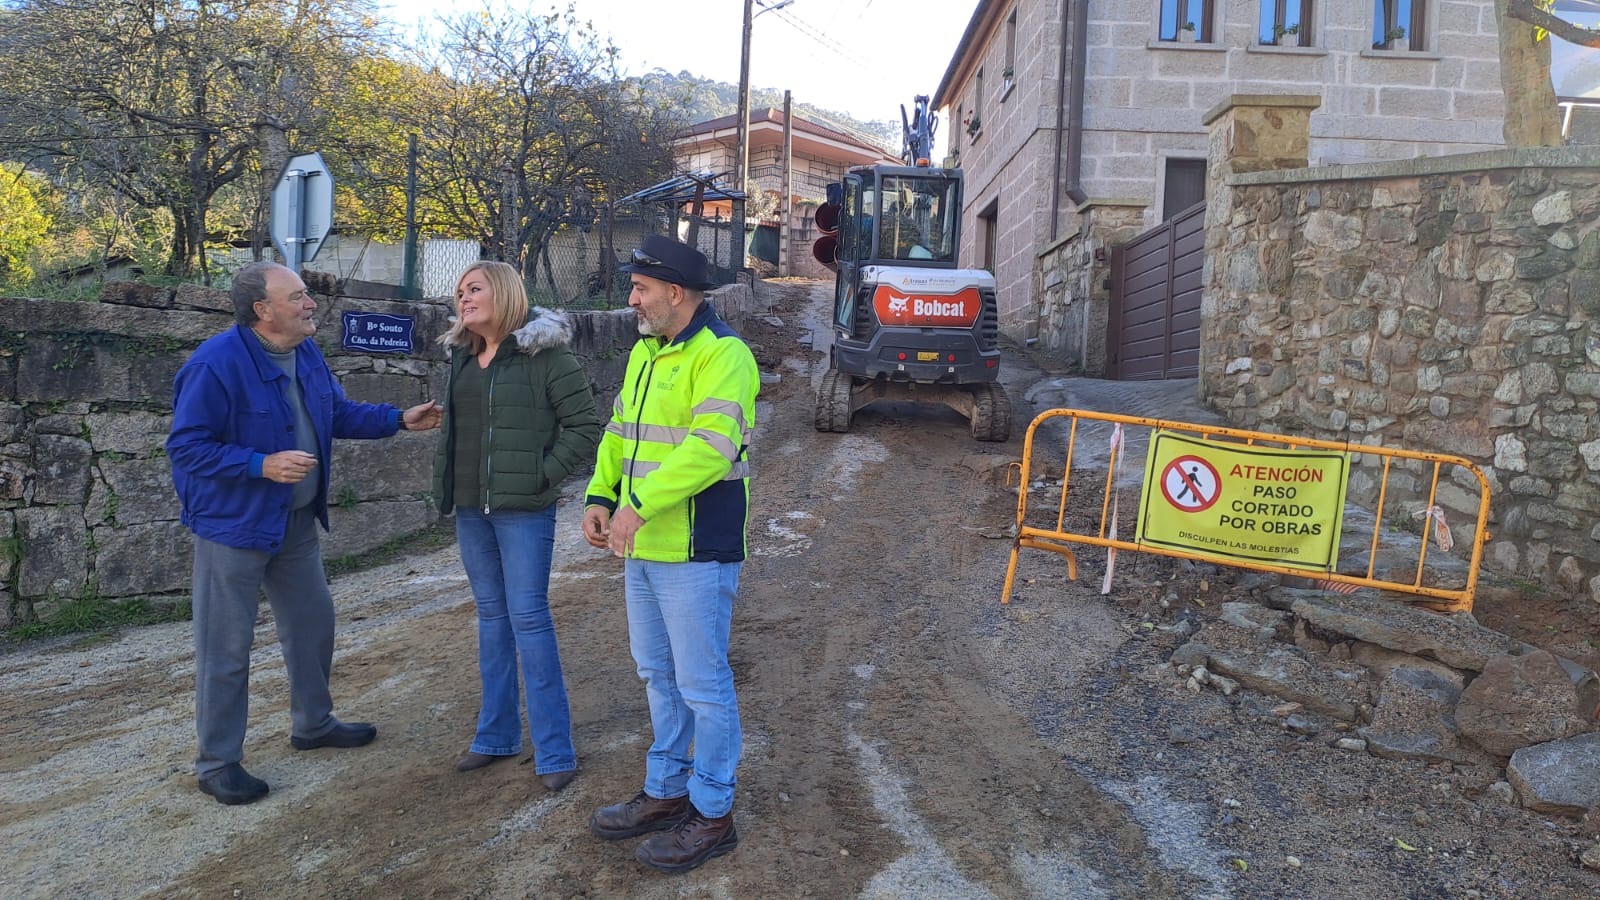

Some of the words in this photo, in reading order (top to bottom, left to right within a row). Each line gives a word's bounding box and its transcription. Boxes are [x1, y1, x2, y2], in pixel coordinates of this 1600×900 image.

[914, 299, 965, 317] Bobcat
[380, 323, 403, 332] Souto
[370, 337, 378, 345] da
[380, 338, 408, 346] Pedreira
[1230, 464, 1323, 483] ATENCIÓN
[1253, 486, 1297, 498] PASO
[1231, 500, 1314, 518] CORTADO
[1220, 515, 1256, 530] POR
[1262, 521, 1322, 535] OBRAS
[1178, 530, 1228, 546] DISCULPEN
[1230, 541, 1248, 550] LAS
[1250, 544, 1300, 554] MOLESTIAS
